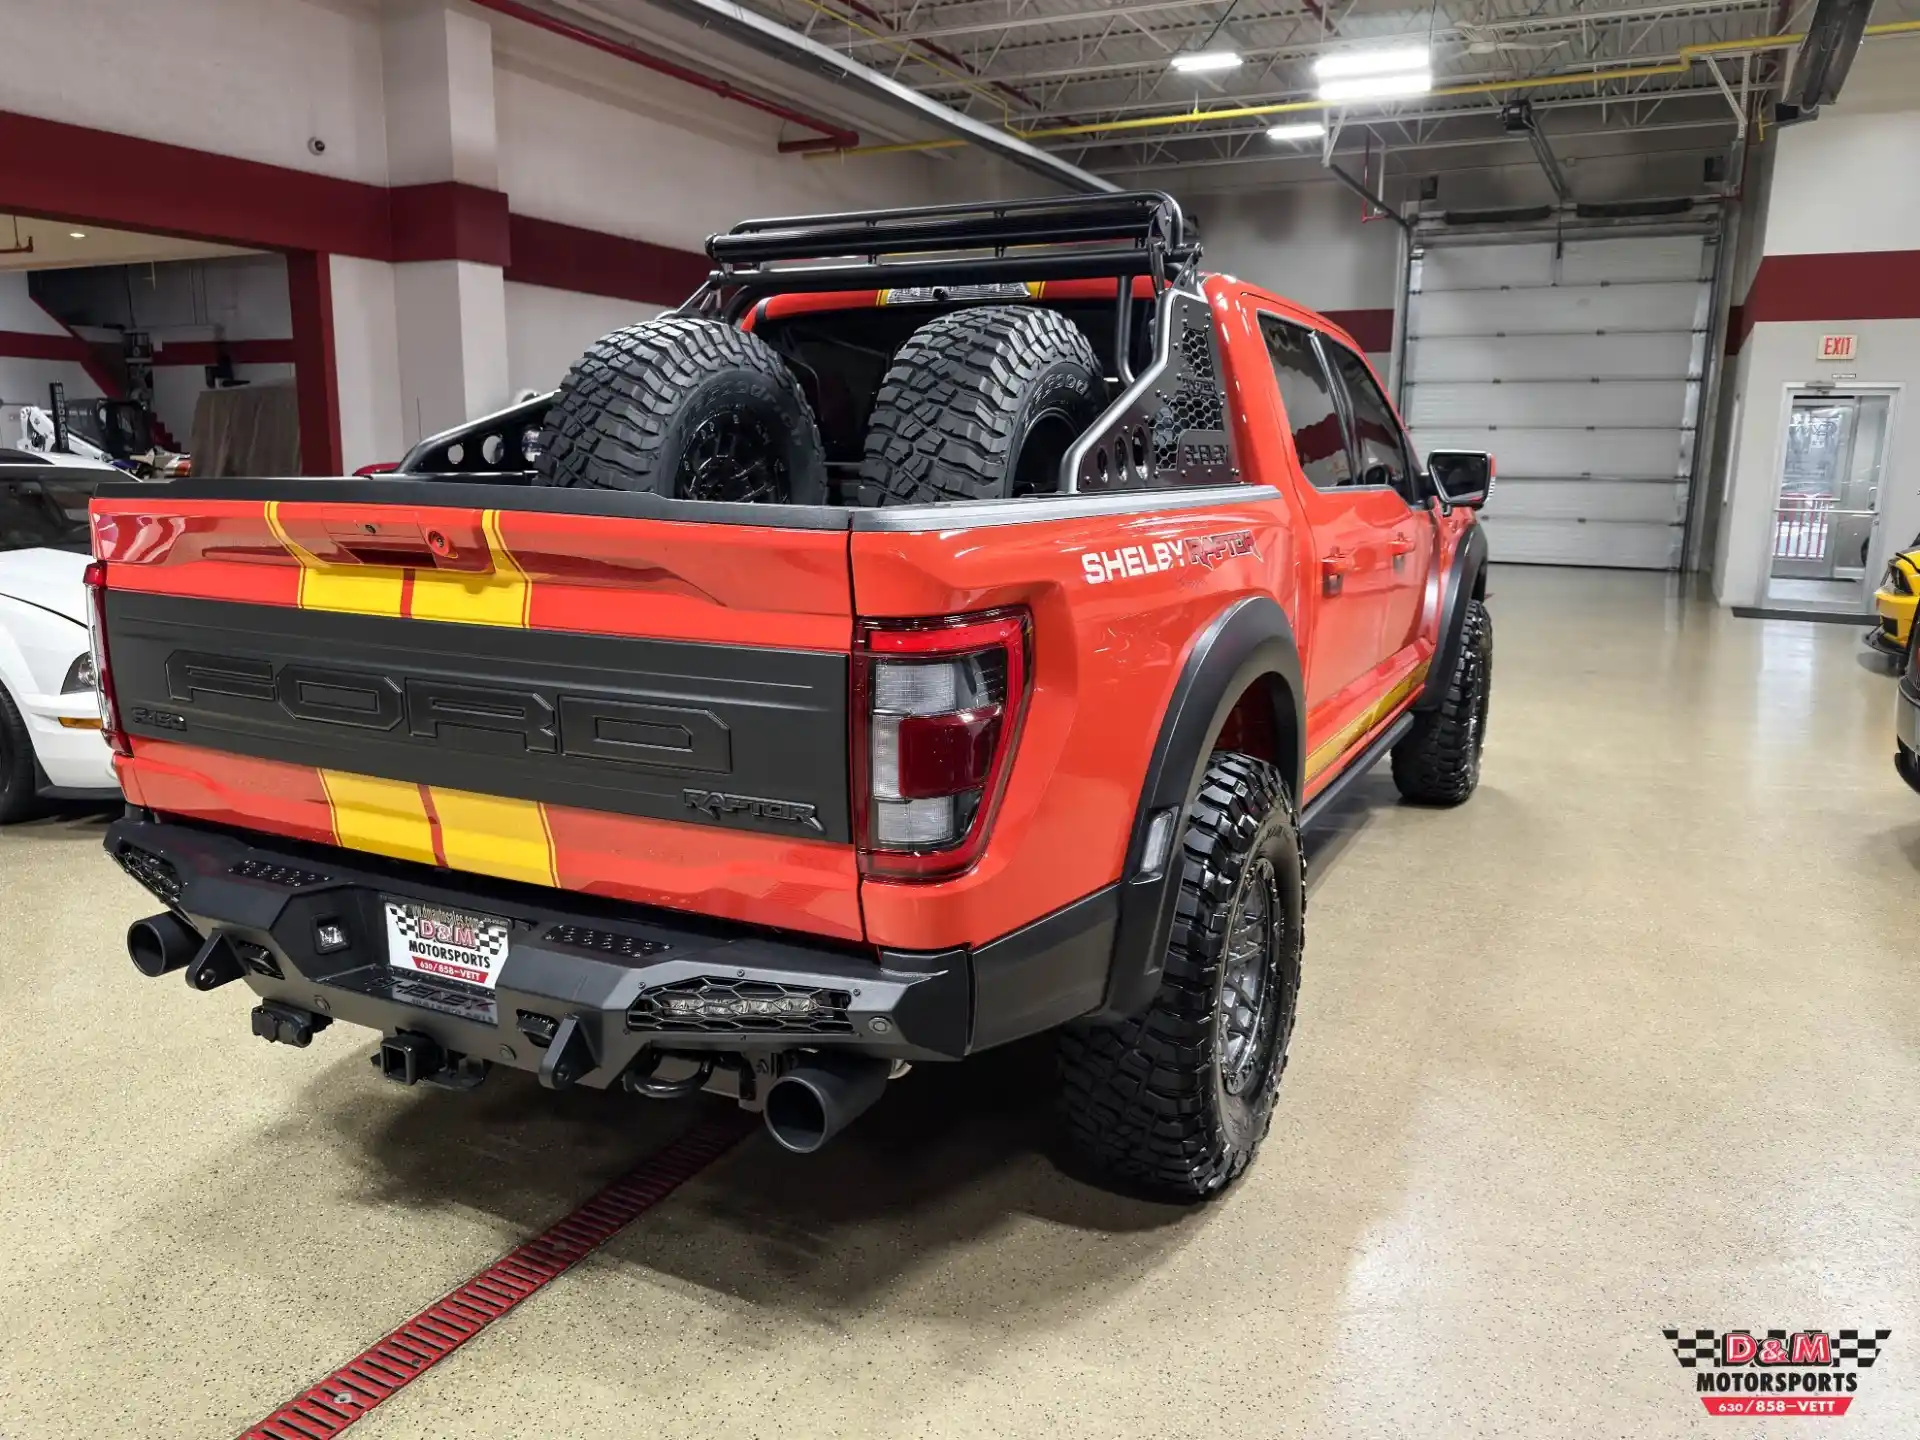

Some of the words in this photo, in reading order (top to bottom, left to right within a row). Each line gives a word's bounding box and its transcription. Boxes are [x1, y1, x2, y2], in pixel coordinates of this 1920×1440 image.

[1824, 336, 1852, 355] EXIT
[1081, 538, 1185, 585] SHELBY
[1184, 529, 1264, 571] RAPTOR
[165, 649, 734, 773] FORD
[683, 788, 827, 834] RAPTOR
[419, 917, 477, 949] D&M
[408, 940, 491, 969] MOTORSPORTS
